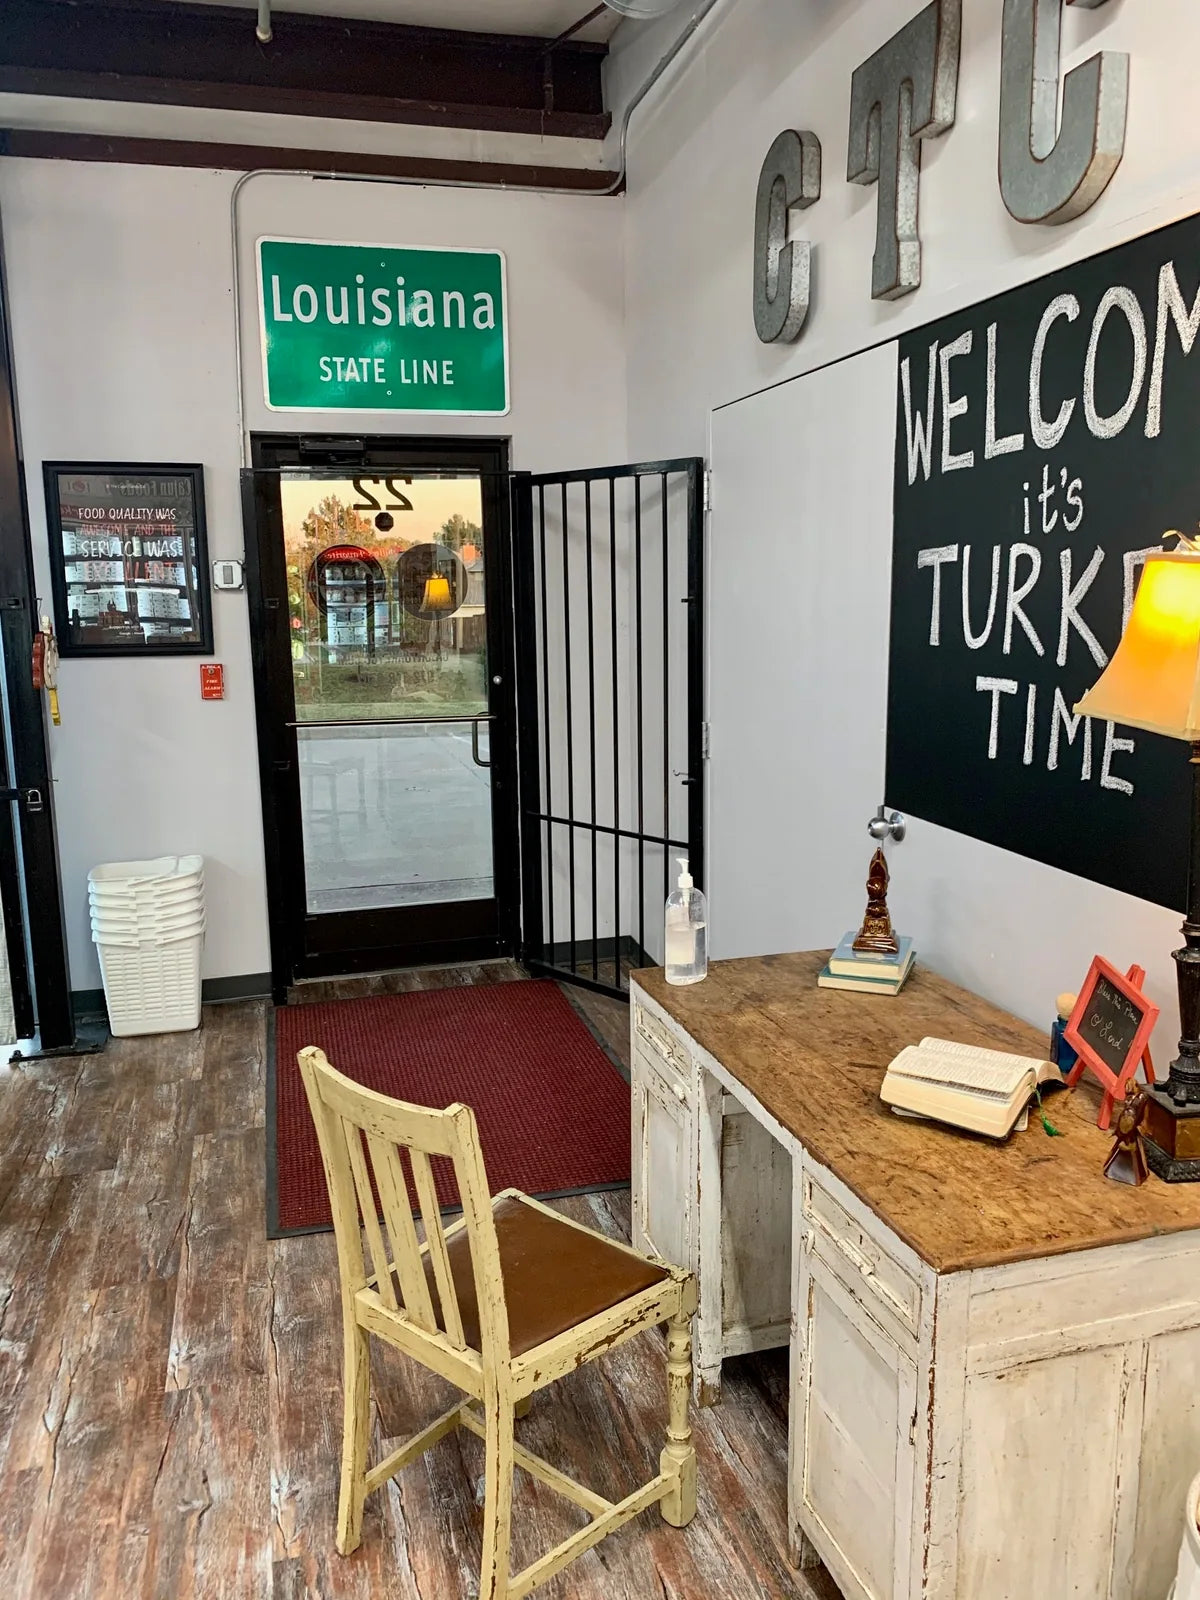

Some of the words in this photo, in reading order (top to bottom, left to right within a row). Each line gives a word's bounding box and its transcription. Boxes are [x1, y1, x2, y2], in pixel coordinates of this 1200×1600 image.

[271, 274, 496, 330] Louisiana
[319, 356, 386, 384] STATE
[400, 359, 454, 385] LINE
[78, 507, 105, 520] FOOD
[108, 507, 154, 520] QUALITY
[155, 507, 177, 520] WAS
[1023, 463, 1084, 535] it's
[134, 523, 155, 536] AND
[159, 523, 177, 536] THE
[81, 539, 142, 559] SERVICE
[146, 539, 179, 558] WAS
[975, 675, 1136, 797] TIME
